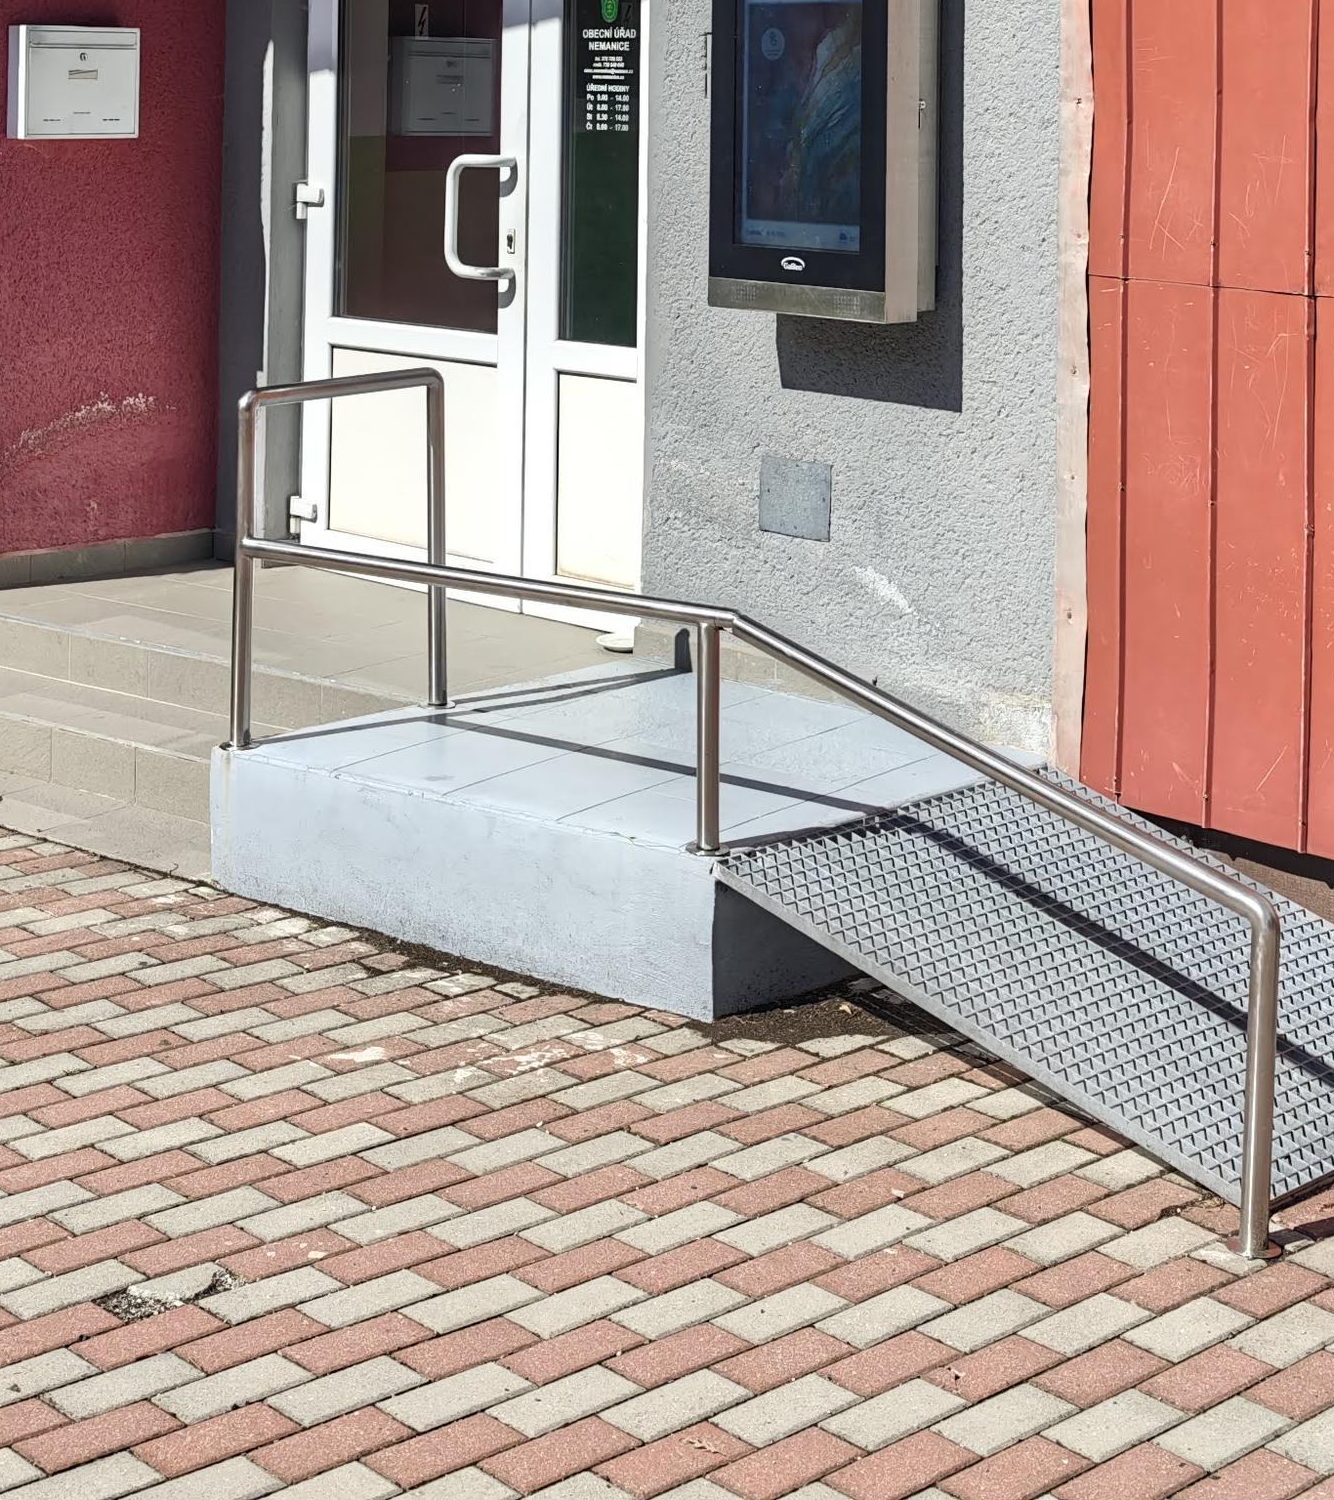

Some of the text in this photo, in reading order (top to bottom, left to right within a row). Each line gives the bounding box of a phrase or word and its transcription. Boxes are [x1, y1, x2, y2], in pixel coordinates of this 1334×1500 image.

[582, 26, 637, 38] OBECNÍ ÚŘAD
[588, 41, 630, 51] NEMANICE
